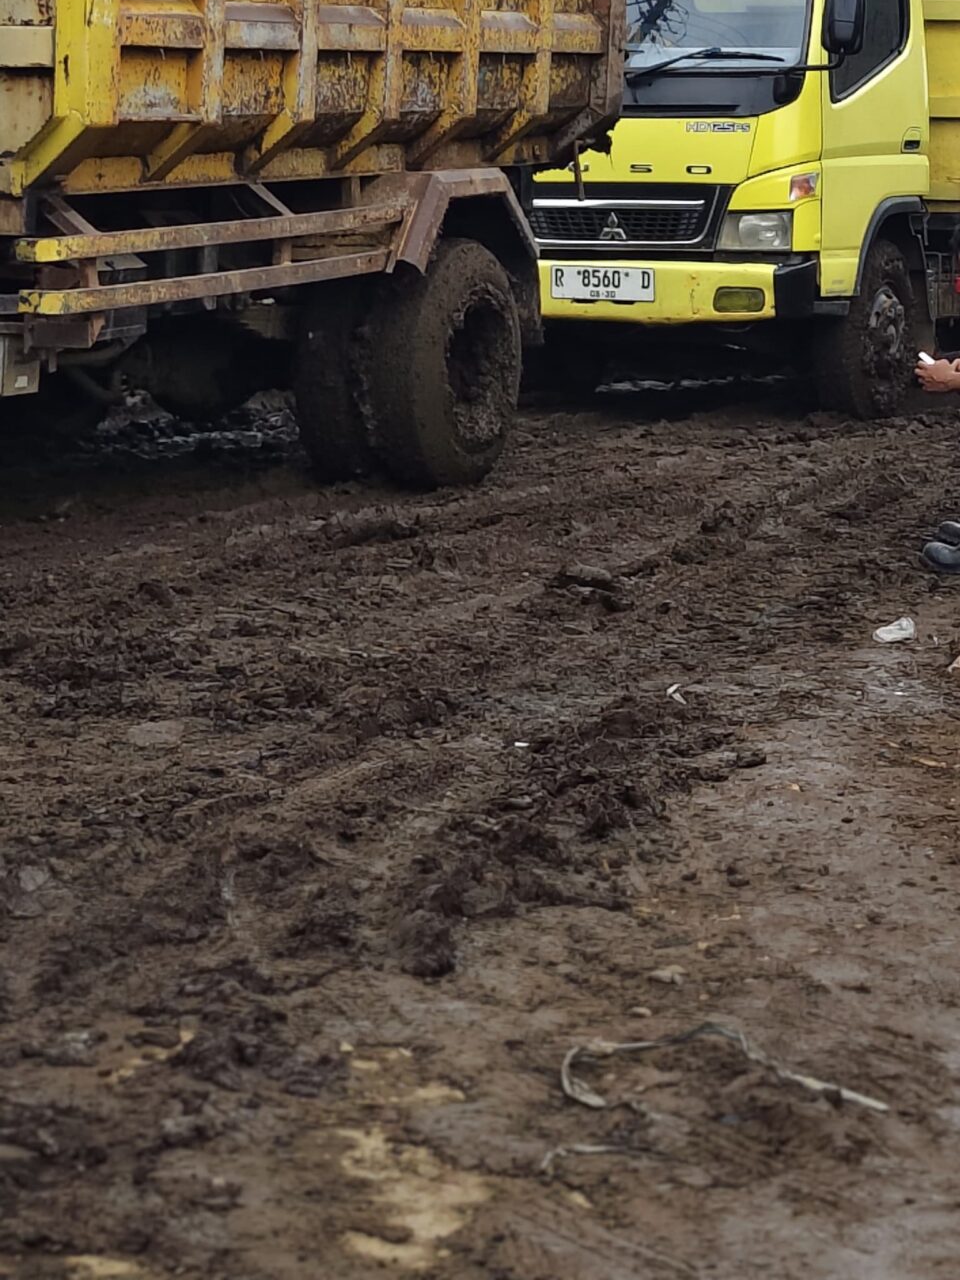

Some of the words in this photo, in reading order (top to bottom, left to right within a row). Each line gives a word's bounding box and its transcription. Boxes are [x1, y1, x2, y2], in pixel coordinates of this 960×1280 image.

[555, 268, 564, 288] R
[582, 269, 620, 289] 8560
[641, 270, 650, 289] D
